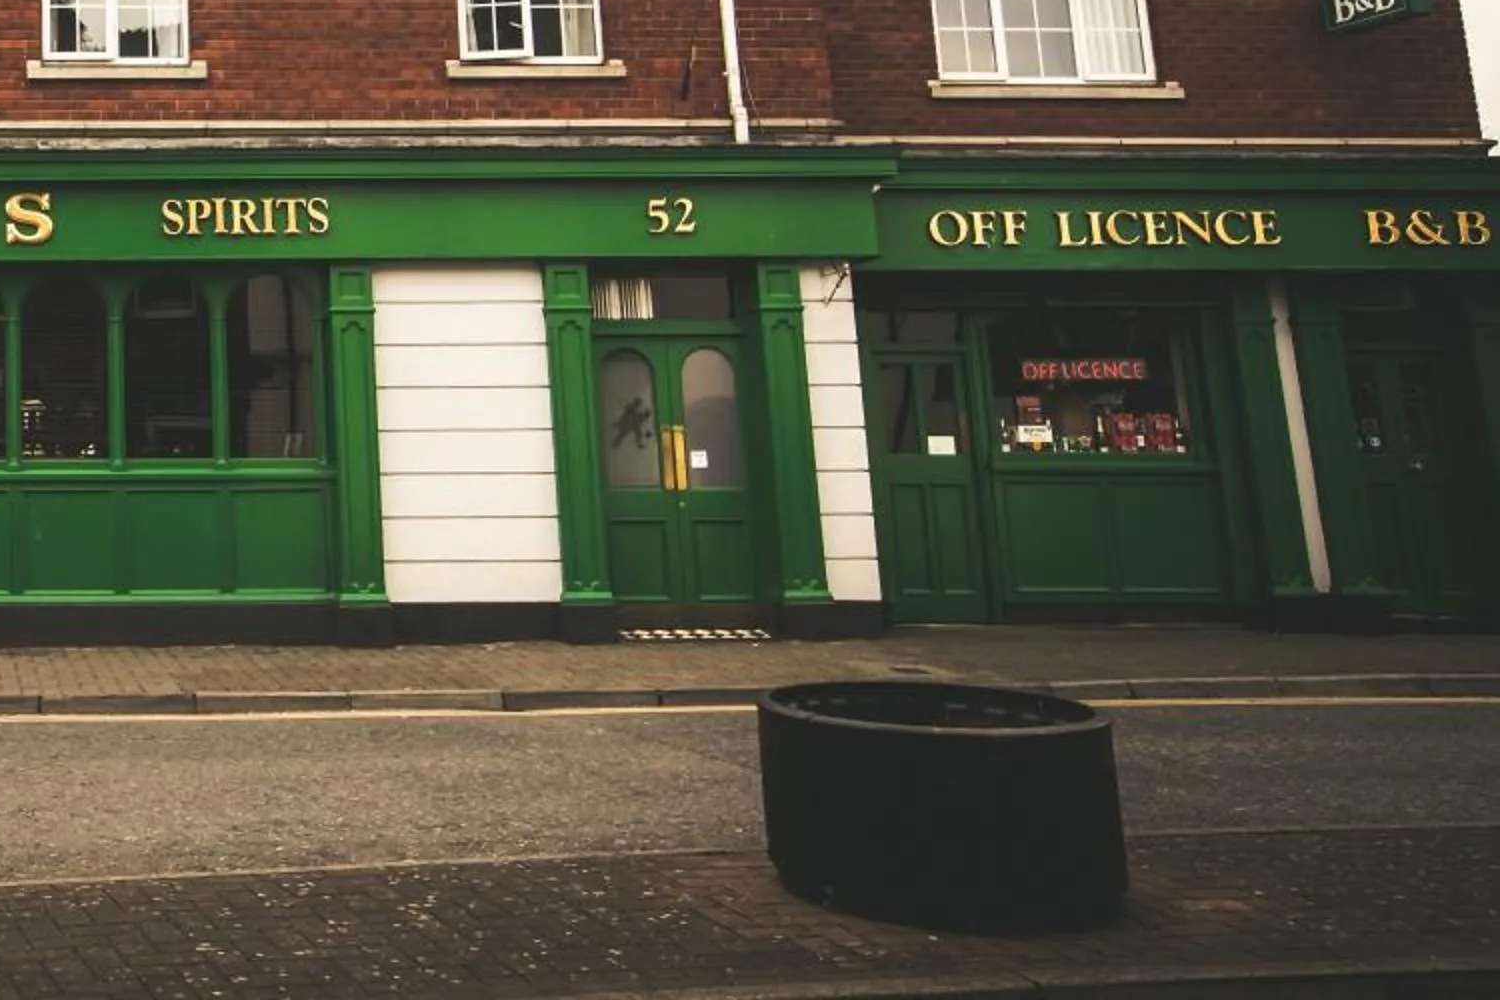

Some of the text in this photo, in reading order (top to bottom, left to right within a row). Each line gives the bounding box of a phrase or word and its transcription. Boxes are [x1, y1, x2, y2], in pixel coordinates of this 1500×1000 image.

[162, 197, 330, 236] SPIRITS
[646, 197, 697, 234] 52
[929, 209, 1282, 247] OFF LICENCE
[1365, 209, 1492, 246] B&B
[1023, 360, 1145, 380] OFF LICENCE
